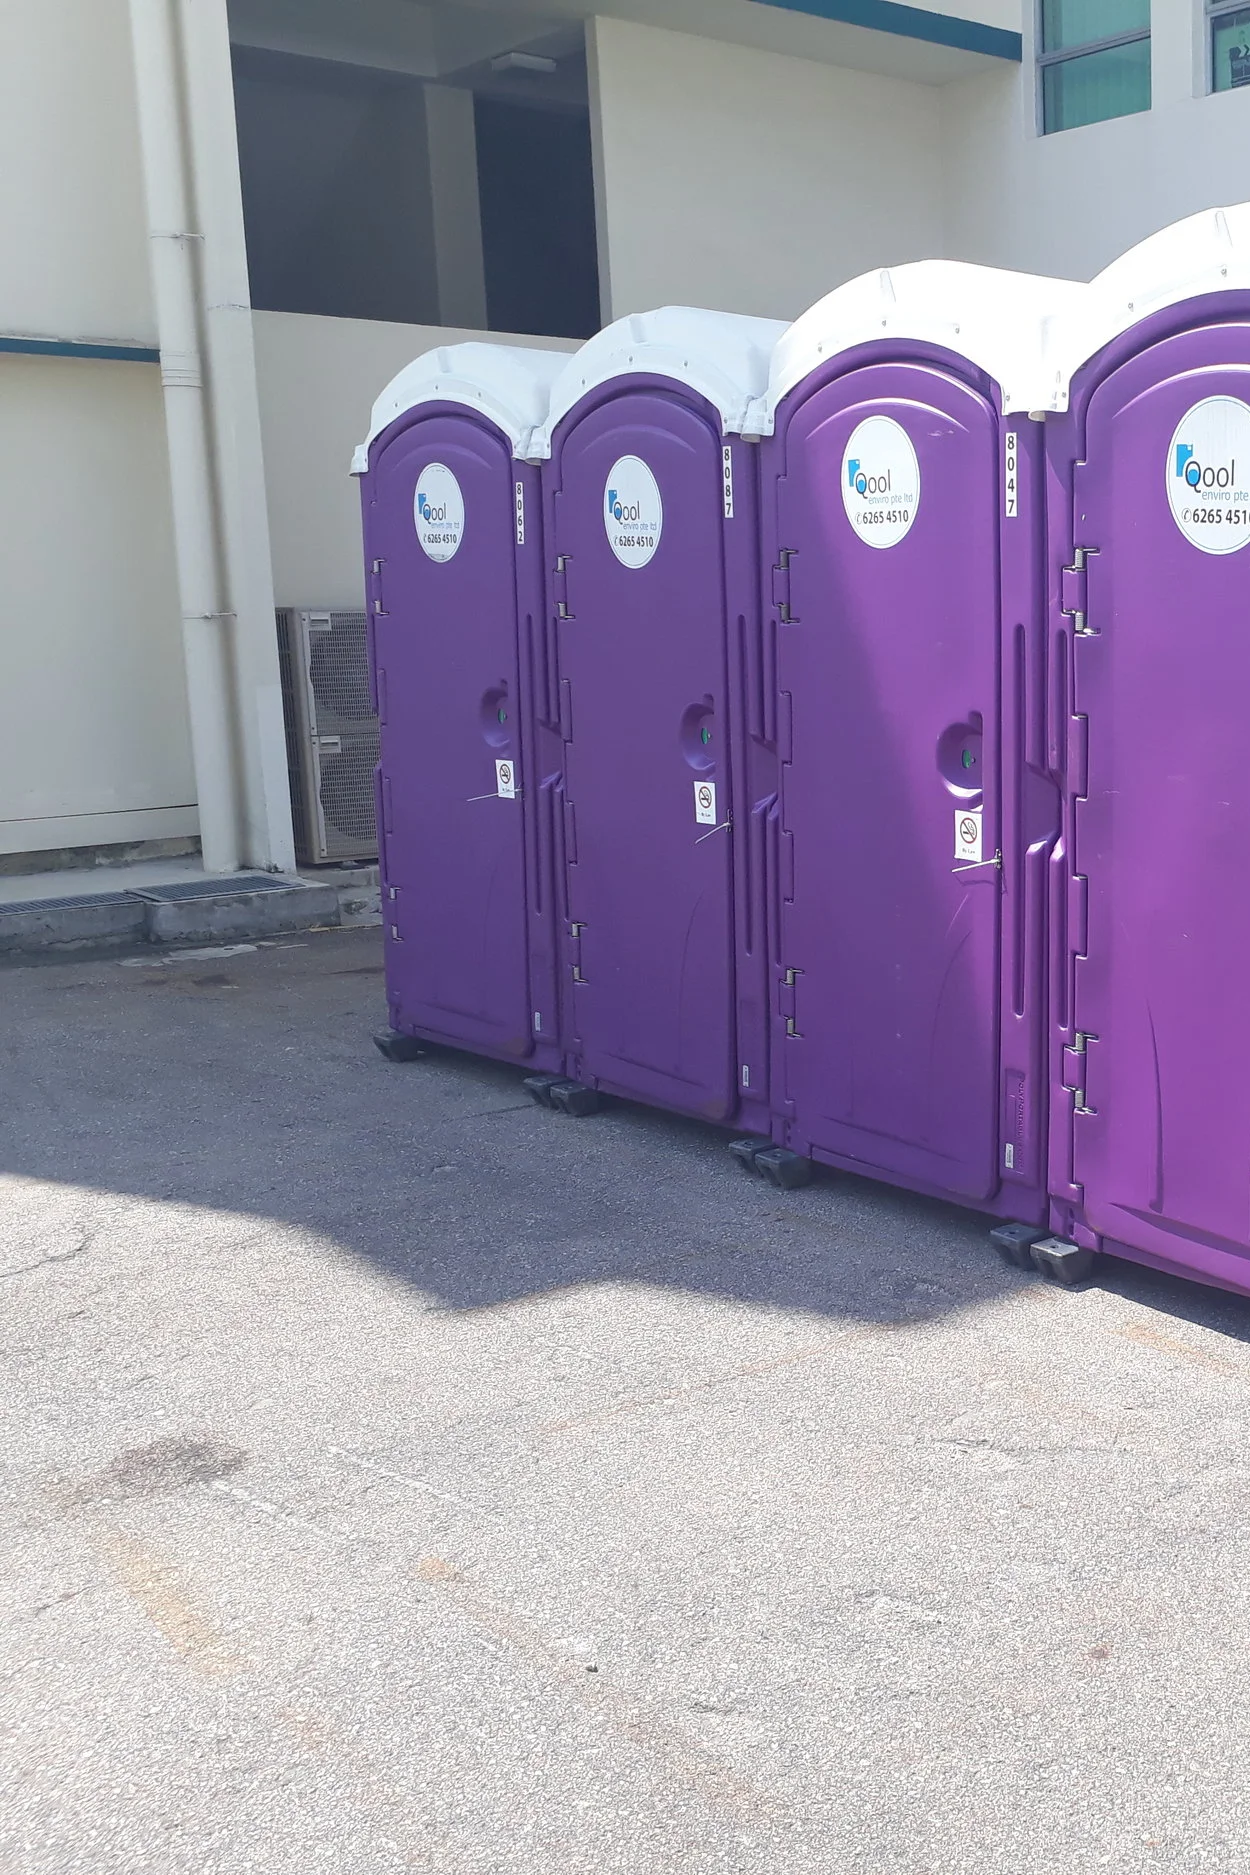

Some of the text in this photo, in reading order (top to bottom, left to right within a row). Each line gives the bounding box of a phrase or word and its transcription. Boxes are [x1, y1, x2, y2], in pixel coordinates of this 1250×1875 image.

[724, 448, 732, 515] 8087
[856, 469, 891, 499] Qool
[1007, 435, 1015, 514] 8047
[1185, 459, 1235, 493] Qool
[868, 493, 913, 506] enviro pte ltd
[1201, 490, 1231, 501] enviro
[1233, 491, 1249, 503] pte
[423, 502, 447, 524] Qool
[613, 500, 640, 525] Qool
[862, 509, 909, 524] 6265 4510
[1192, 508, 1222, 524] 6265
[427, 534, 458, 544] 6265 4510
[619, 536, 654, 547] 6265 4510
